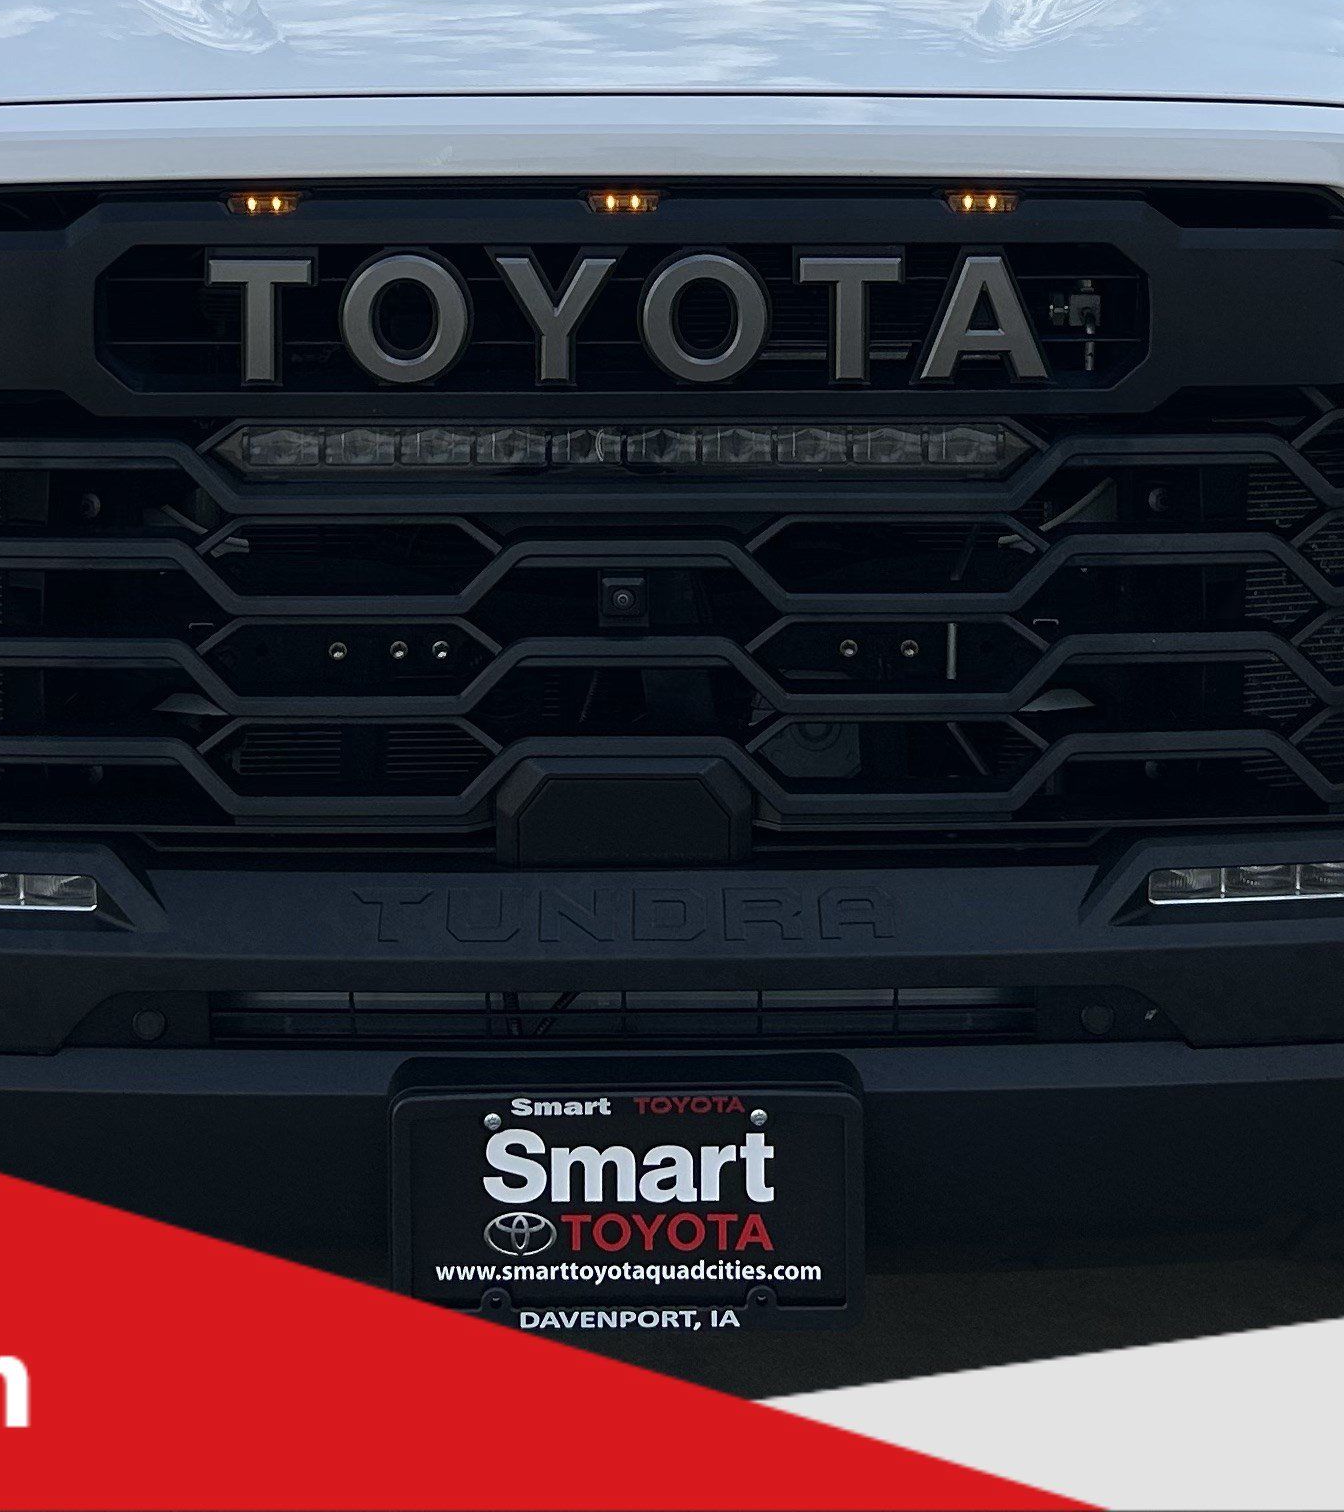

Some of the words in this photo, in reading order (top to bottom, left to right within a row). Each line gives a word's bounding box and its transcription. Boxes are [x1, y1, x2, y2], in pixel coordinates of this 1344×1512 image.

[206, 251, 1050, 384] TOYOTA
[351, 886, 898, 943] TUNDRA
[510, 1097, 612, 1117] Smart
[634, 1096, 746, 1115] TOYOTA
[482, 1128, 775, 1204] Smart
[560, 1212, 774, 1253] TOYOTA
[435, 1259, 822, 1286] www.smarttoyotaquadcities.com
[519, 1310, 702, 1331] DAVENPORT,
[710, 1309, 741, 1328] IA
